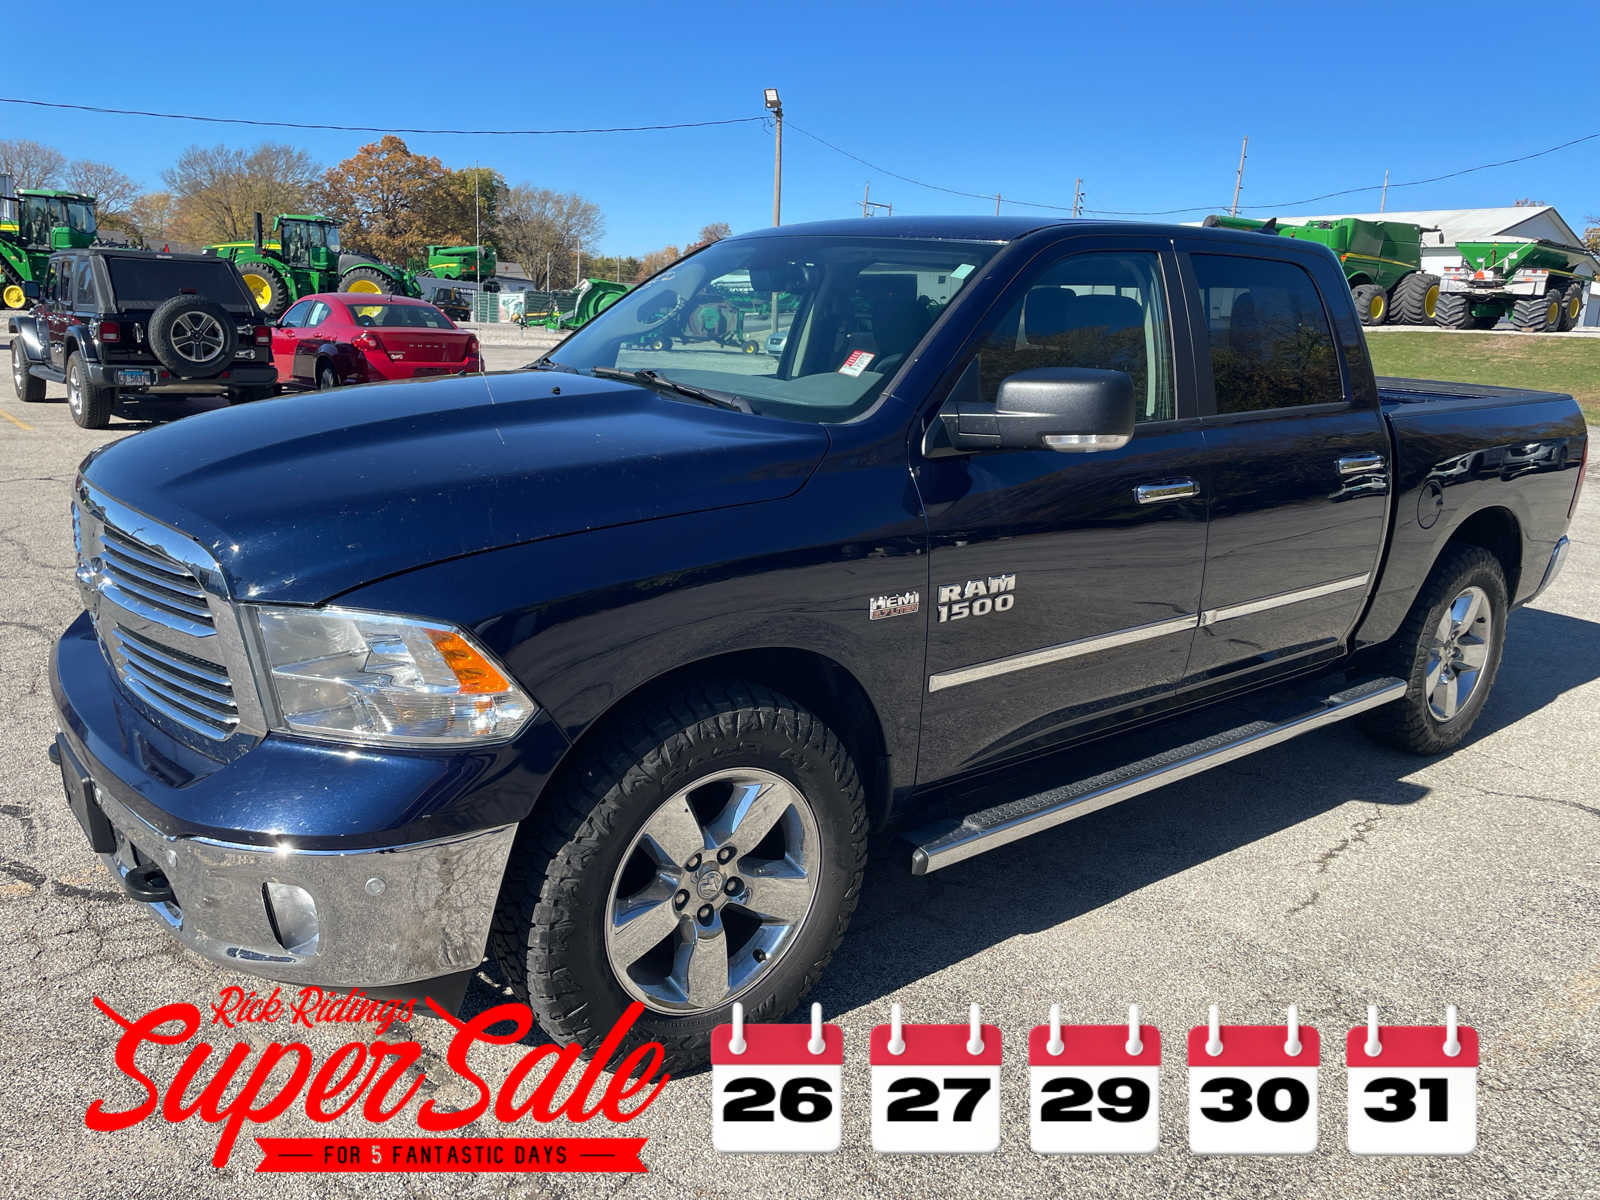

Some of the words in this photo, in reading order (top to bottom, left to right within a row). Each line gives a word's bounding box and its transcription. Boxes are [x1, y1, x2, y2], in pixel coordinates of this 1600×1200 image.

[869, 591, 920, 610] HEMI
[938, 573, 1017, 603] RAM
[938, 594, 1015, 623] 1500
